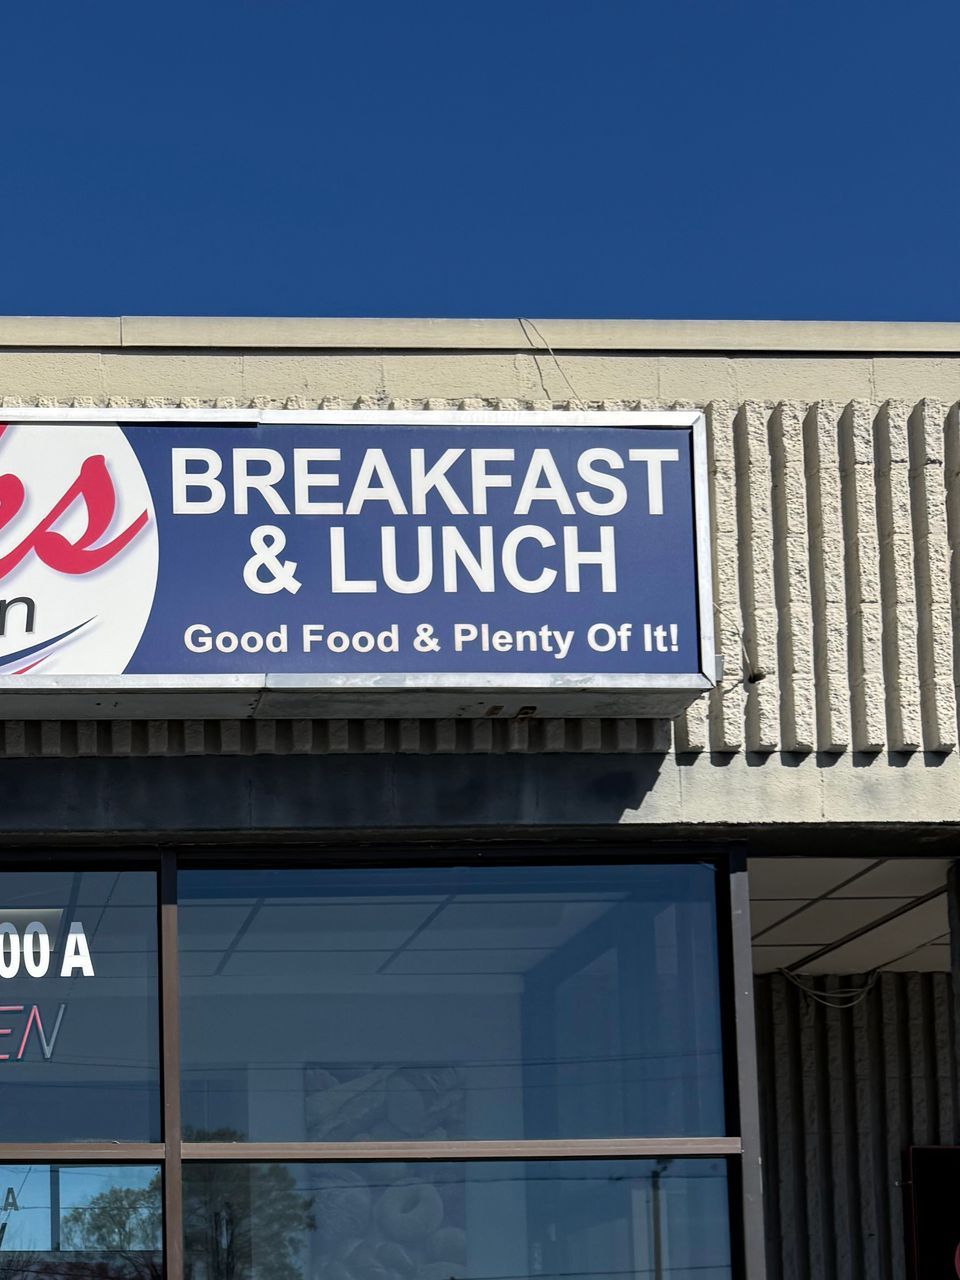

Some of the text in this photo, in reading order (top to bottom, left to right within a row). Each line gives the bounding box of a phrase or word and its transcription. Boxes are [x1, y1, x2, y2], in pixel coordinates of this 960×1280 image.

[171, 447, 679, 516] BREAKFAST
[243, 525, 617, 595] & LUNCH
[183, 623, 680, 660] Good Food & Plenty Of It!
